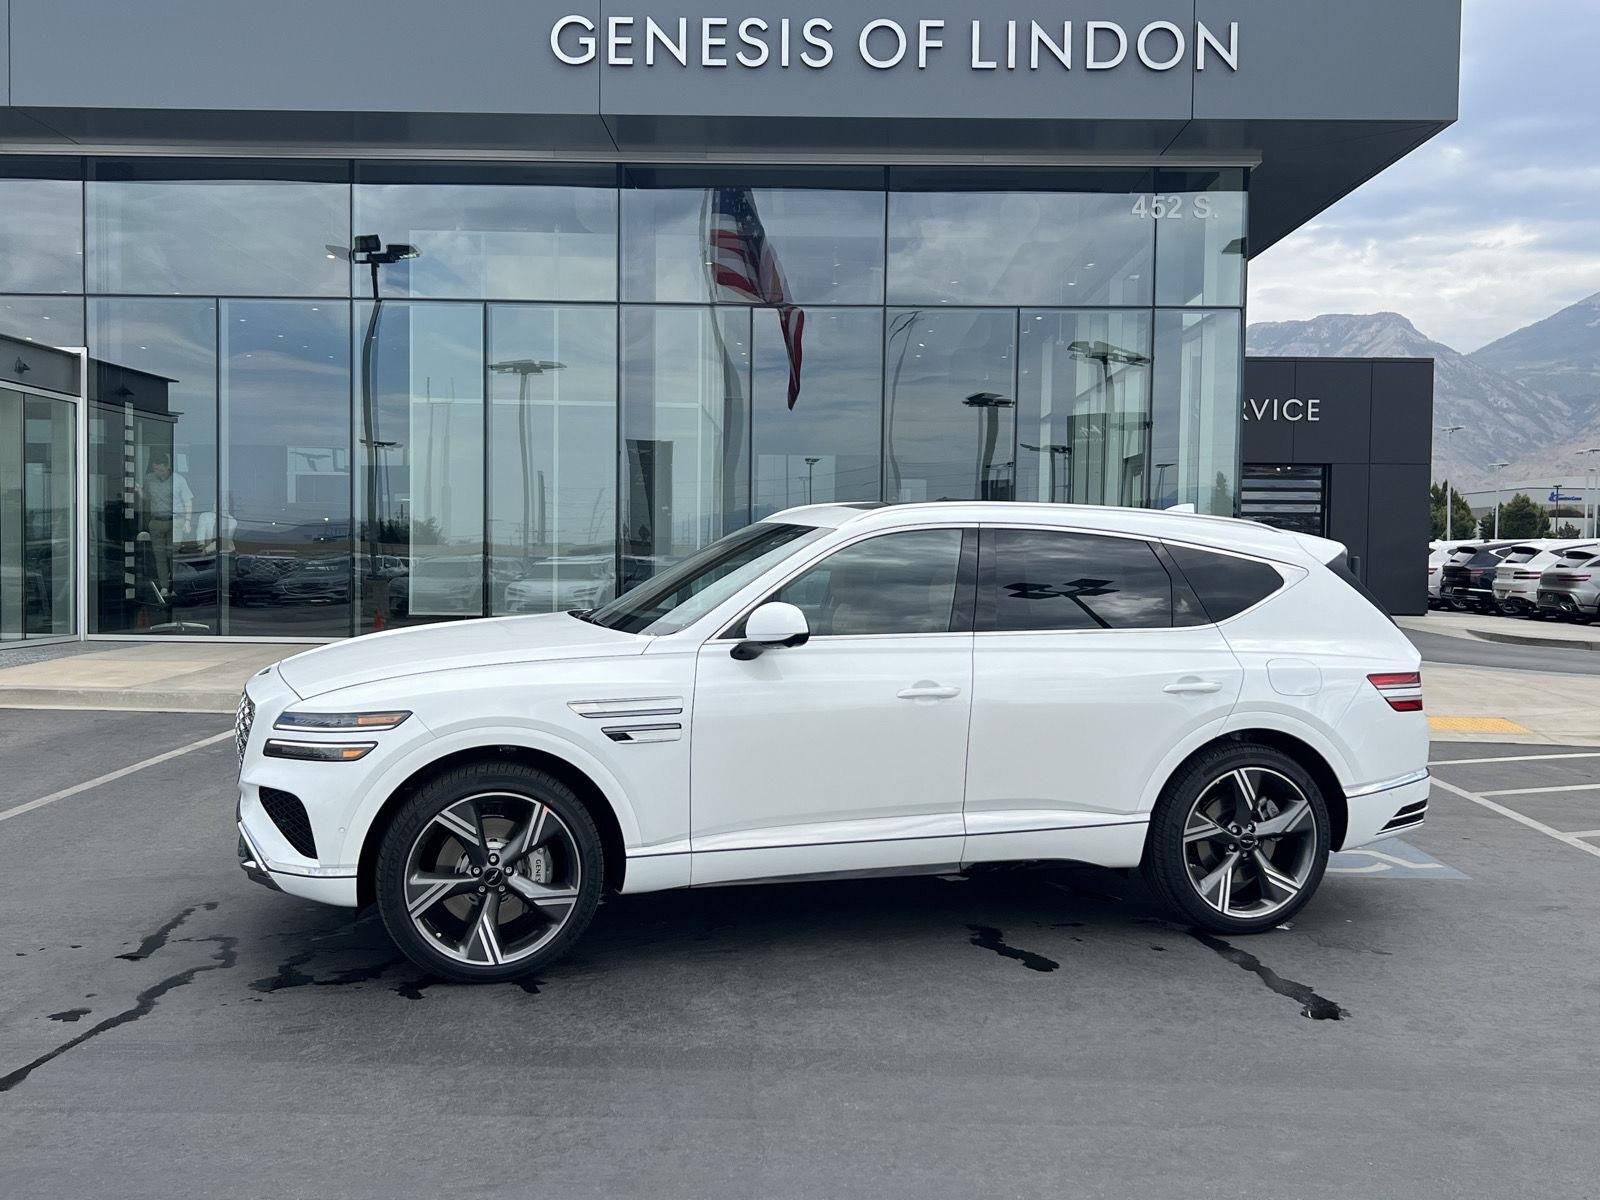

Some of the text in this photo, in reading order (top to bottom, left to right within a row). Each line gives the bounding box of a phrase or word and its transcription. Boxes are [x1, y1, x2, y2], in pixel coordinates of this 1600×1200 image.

[550, 14, 1239, 71] GENESIS OF LINDON
[1131, 195, 1220, 219] 452 S.
